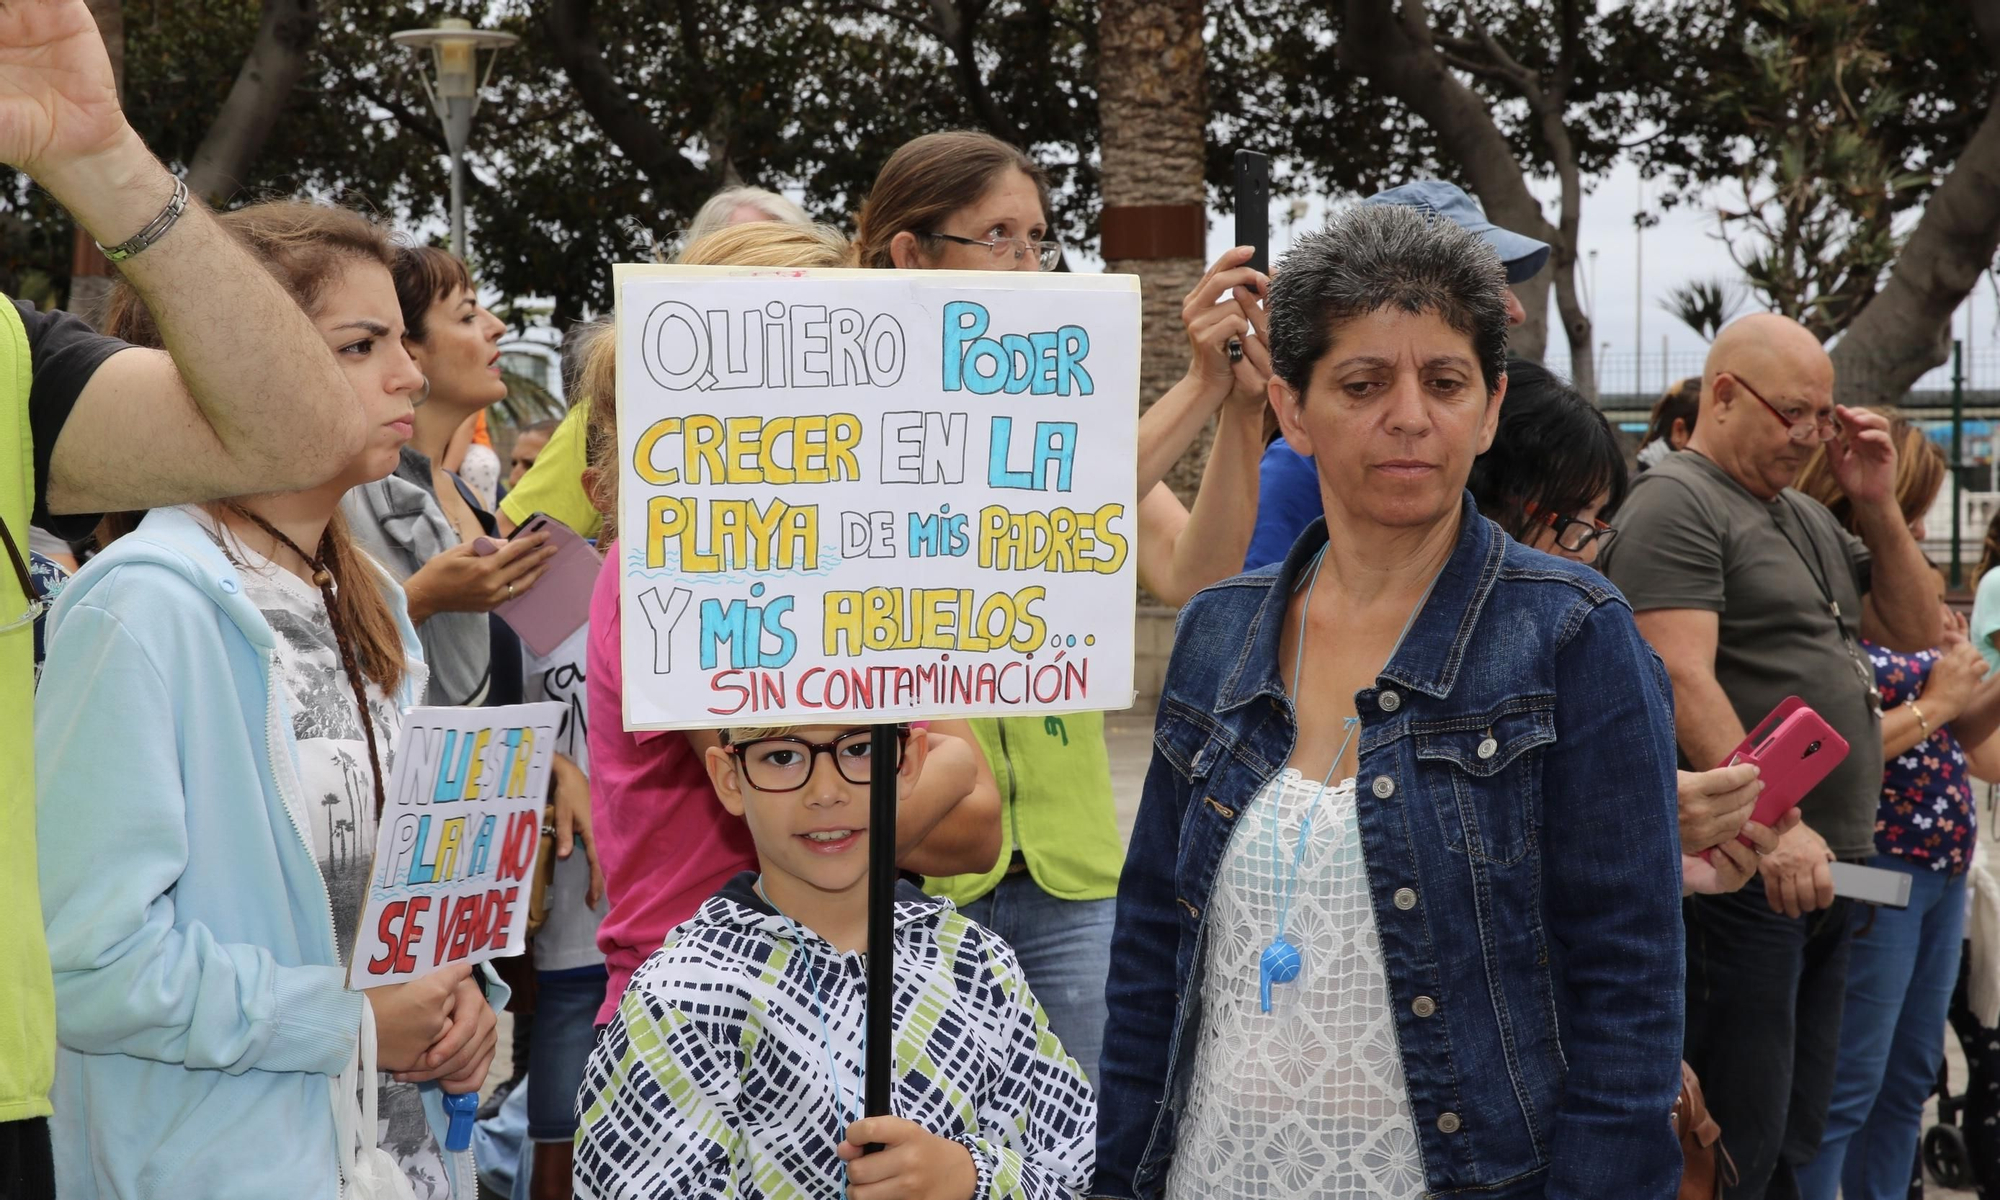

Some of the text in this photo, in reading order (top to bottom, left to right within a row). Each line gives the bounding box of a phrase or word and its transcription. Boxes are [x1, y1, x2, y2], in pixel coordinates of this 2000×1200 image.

[942, 301, 1095, 396] PODER
[633, 411, 1078, 492] CRECER EN LA
[646, 496, 819, 574] PLAYA
[840, 511, 896, 559] DE
[978, 503, 1129, 574] PADRES
[638, 586, 693, 674] Y
[823, 585, 1096, 657] ABUELOS...
[707, 650, 1089, 715] SIN CONTAMINACIÓN
[383, 809, 538, 889] PLAYA NO
[367, 886, 520, 975] SE VENDE
